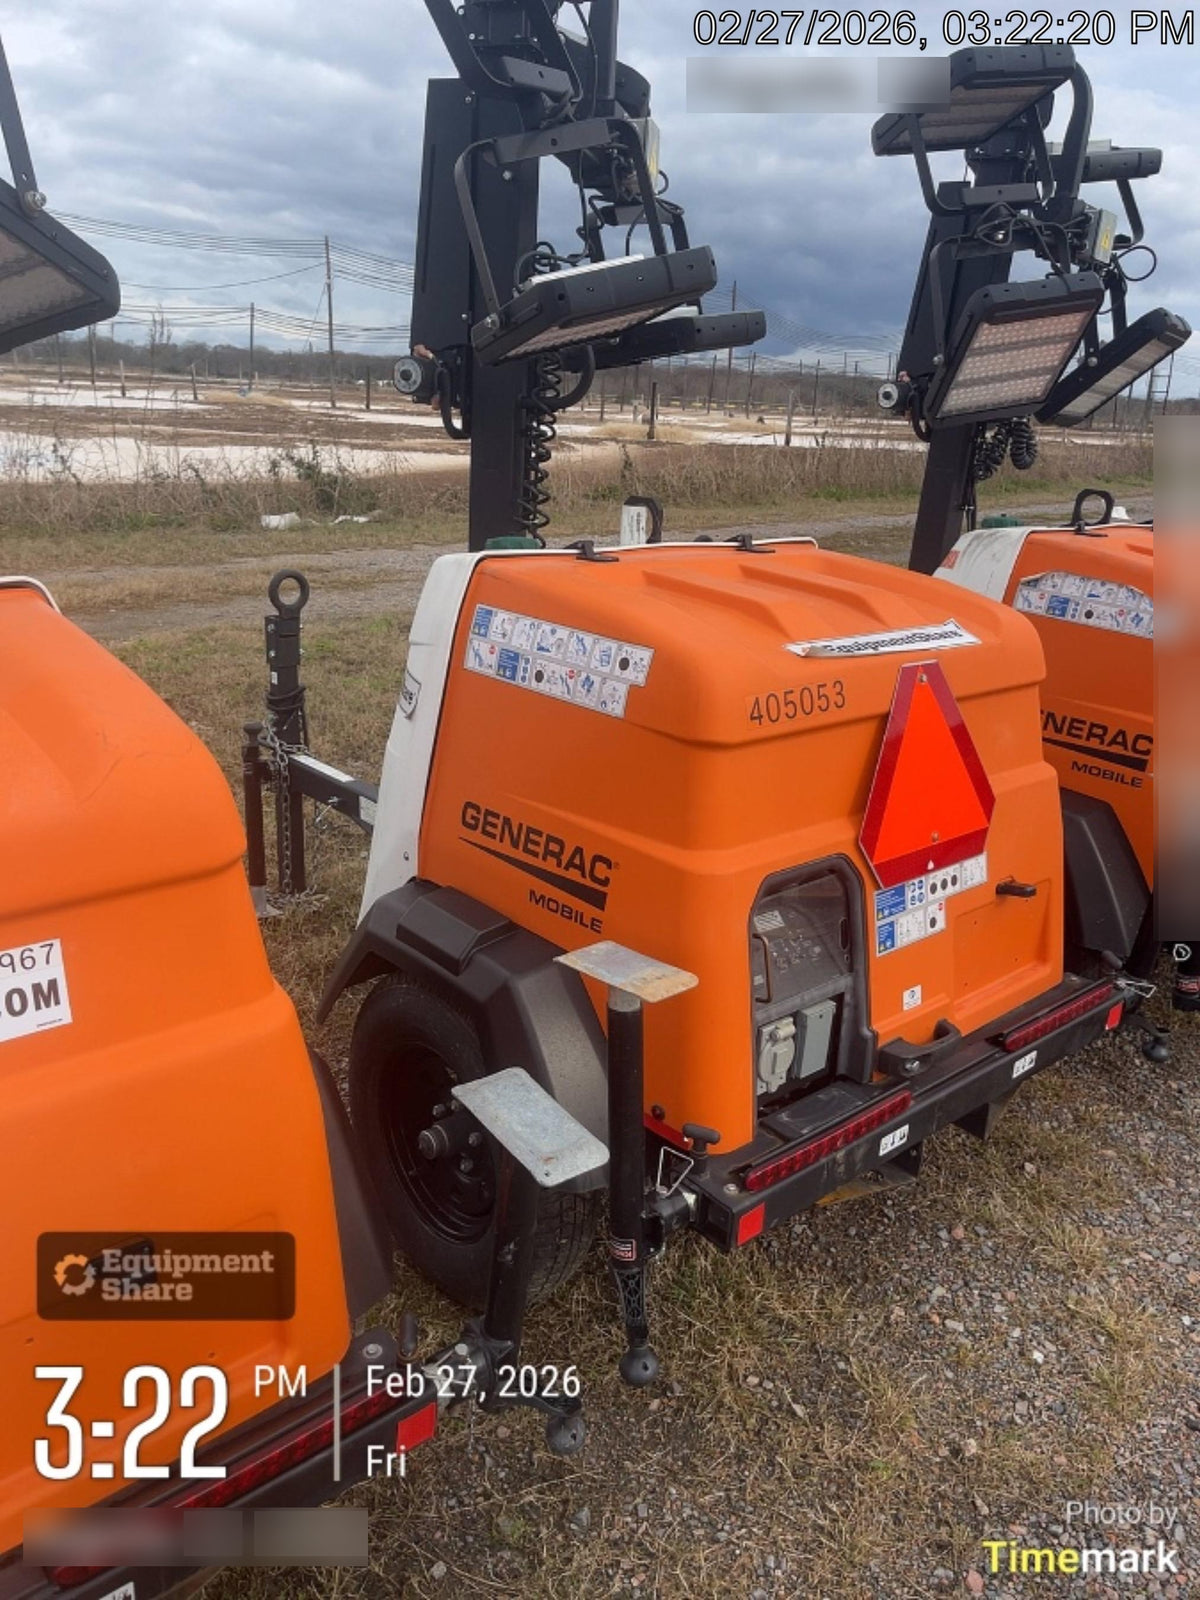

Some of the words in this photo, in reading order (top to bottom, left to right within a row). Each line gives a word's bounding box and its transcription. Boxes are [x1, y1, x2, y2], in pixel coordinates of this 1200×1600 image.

[750, 681, 845, 725] 405053
[1040, 709, 1154, 756] NERAC
[1071, 761, 1143, 788] MOBILE
[461, 801, 613, 888] GENERAC
[529, 889, 603, 934] MOBILE
[0, 942, 54, 973] 967
[0, 977, 61, 1018] OM
